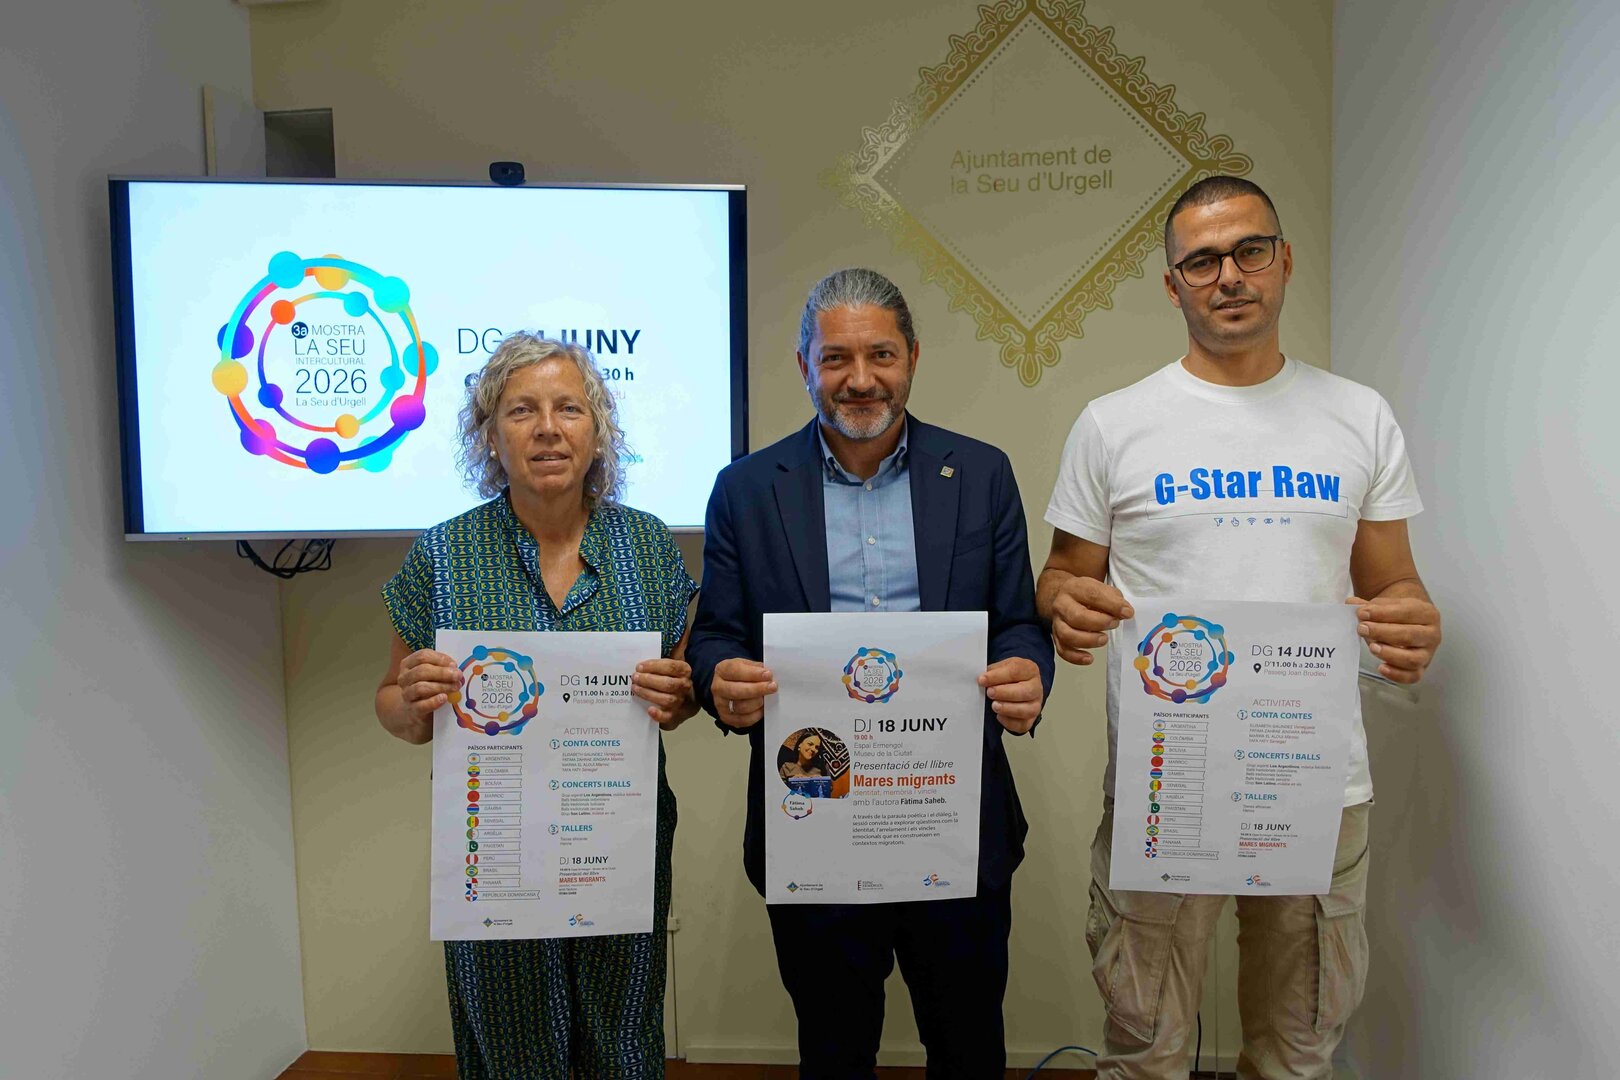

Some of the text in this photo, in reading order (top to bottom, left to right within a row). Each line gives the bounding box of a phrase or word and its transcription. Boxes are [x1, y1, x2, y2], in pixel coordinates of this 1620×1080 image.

[950, 144, 1112, 173] Ajuntament de
[952, 170, 1112, 195] la Seu d'Urgell
[292, 324, 365, 336] 3a MOSTRA
[294, 338, 365, 356] LA SEU
[626, 367, 634, 380] h
[296, 368, 367, 394] 2026
[296, 397, 366, 408] La Seu d'Urgell
[1154, 466, 1340, 506] G-Star Raw
[1251, 644, 1336, 658] DG 14 JUNY
[1169, 660, 1202, 672] 2026
[560, 674, 632, 686] DG 14 JUN
[482, 692, 513, 704] 2026
[1253, 700, 1301, 708] ACTIVITATS
[854, 718, 948, 732] DJ 18 JUNY
[853, 760, 954, 770] Presentació del llibre
[853, 773, 956, 788] Mares migrants
[560, 857, 569, 865] DJ
[584, 856, 609, 864] JUNY
